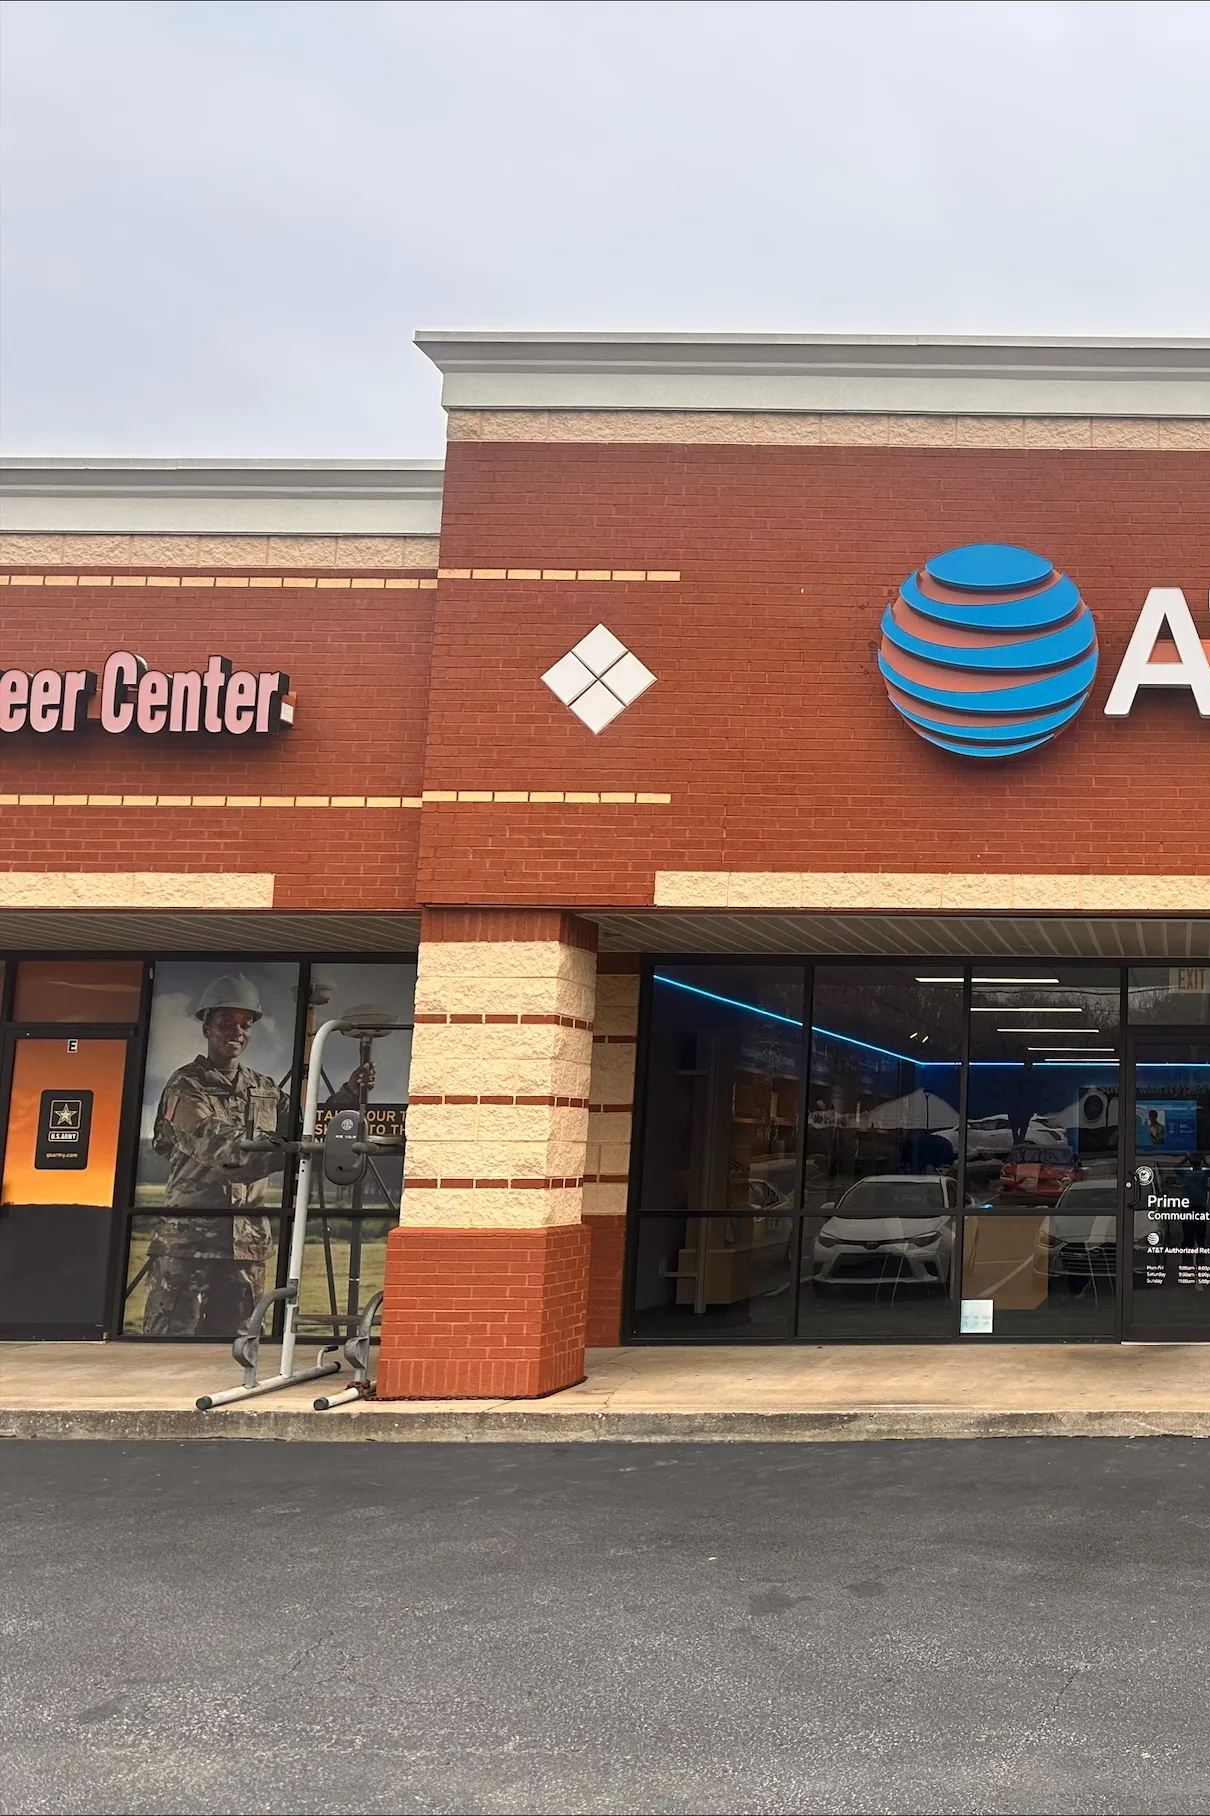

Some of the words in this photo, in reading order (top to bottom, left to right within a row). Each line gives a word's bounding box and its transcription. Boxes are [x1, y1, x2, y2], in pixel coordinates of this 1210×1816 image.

[101, 650, 281, 734] Center
[1178, 968, 1206, 990] EXIT
[68, 1040, 77, 1052] E
[363, 1110, 396, 1122] OUR
[1147, 1194, 1190, 1208] Prime
